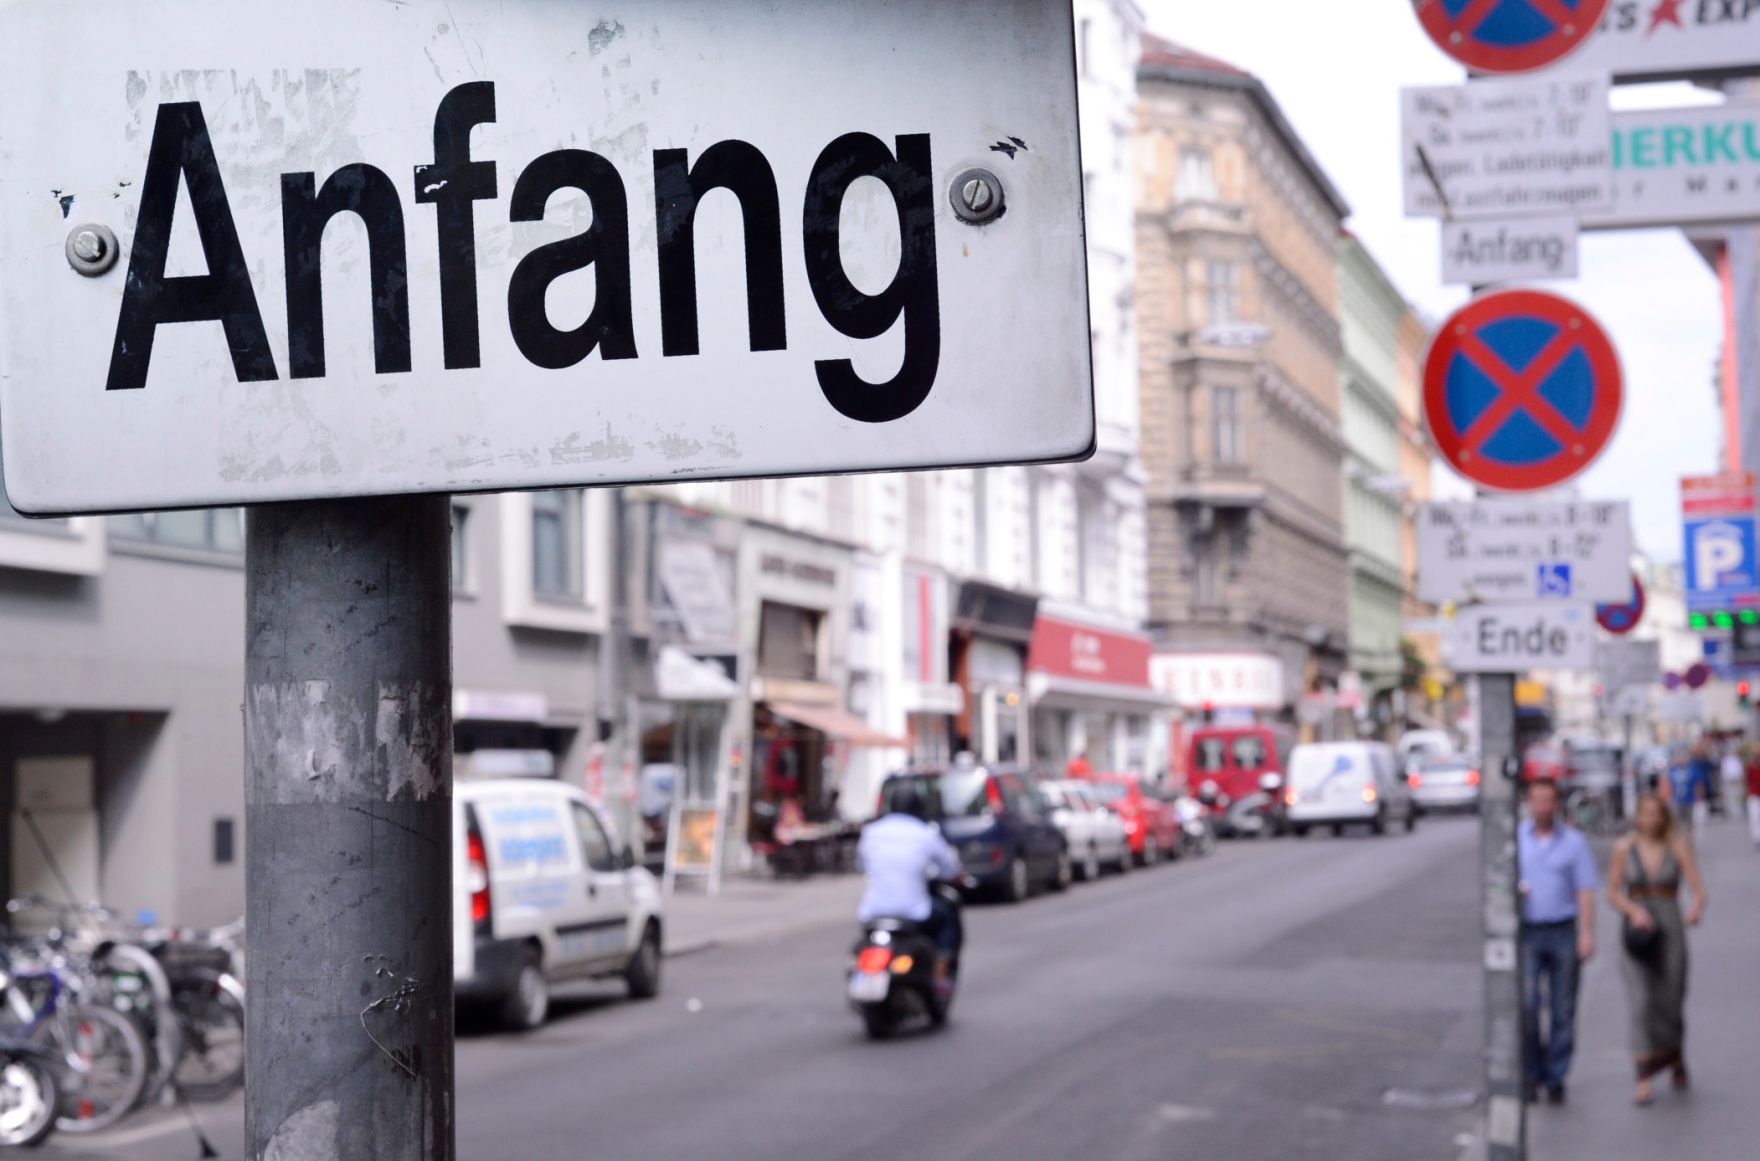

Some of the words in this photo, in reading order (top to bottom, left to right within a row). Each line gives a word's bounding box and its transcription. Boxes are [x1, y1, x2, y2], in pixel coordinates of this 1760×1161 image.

[105, 80, 942, 423] Anfang
[1456, 229, 1565, 271] Anfang
[1478, 616, 1569, 656] Ende
